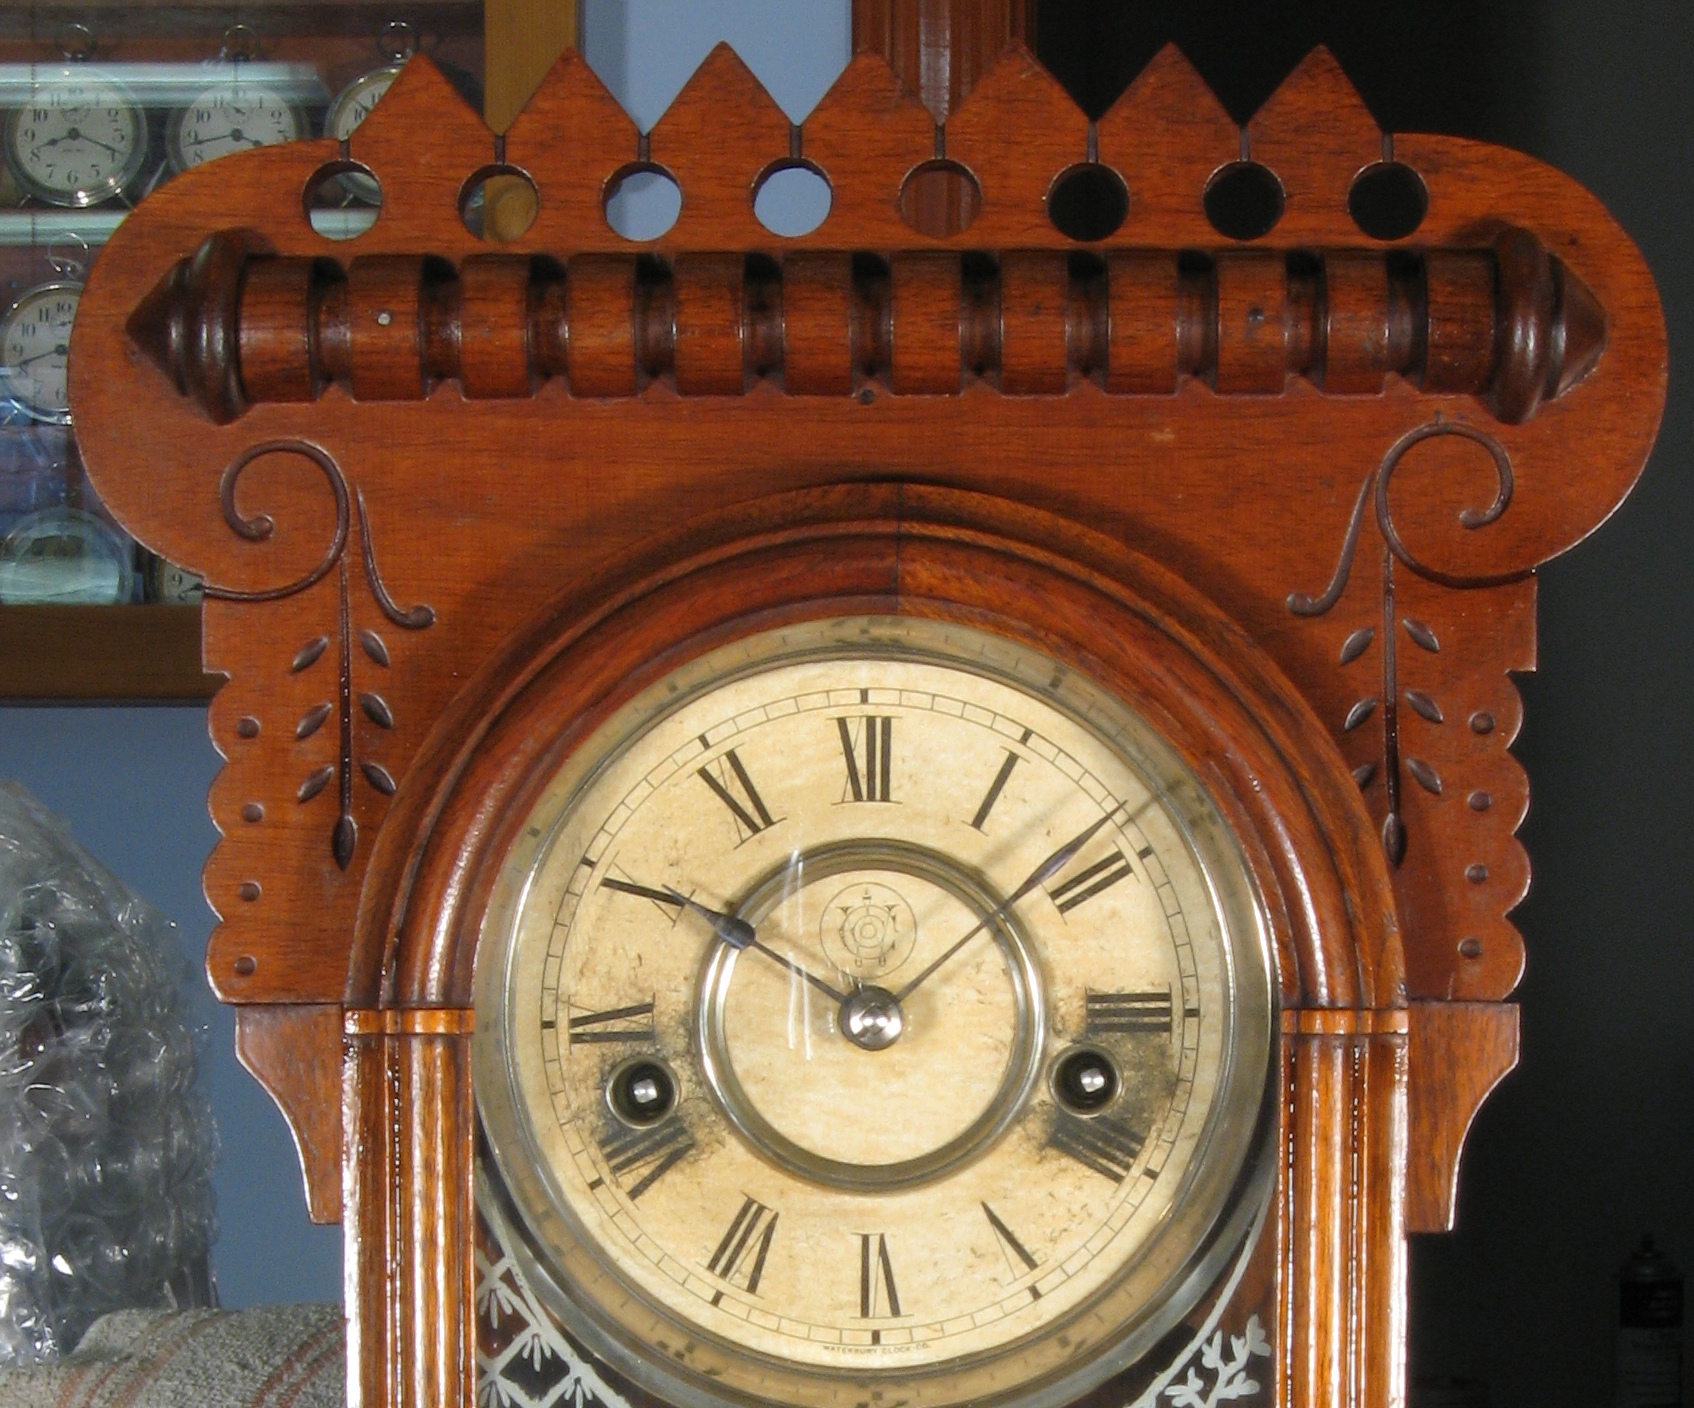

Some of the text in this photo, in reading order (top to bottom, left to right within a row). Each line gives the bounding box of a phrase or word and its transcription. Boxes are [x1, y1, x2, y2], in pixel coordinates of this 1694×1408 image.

[686, 742, 787, 850] XI
[826, 715, 903, 805] XII
[696, 1190, 779, 1299] VII
[850, 1231, 914, 1319] VI
[980, 1200, 1049, 1287] V
[823, 1344, 878, 1355] WATERBURY
[882, 1346, 911, 1354] CLOCK
